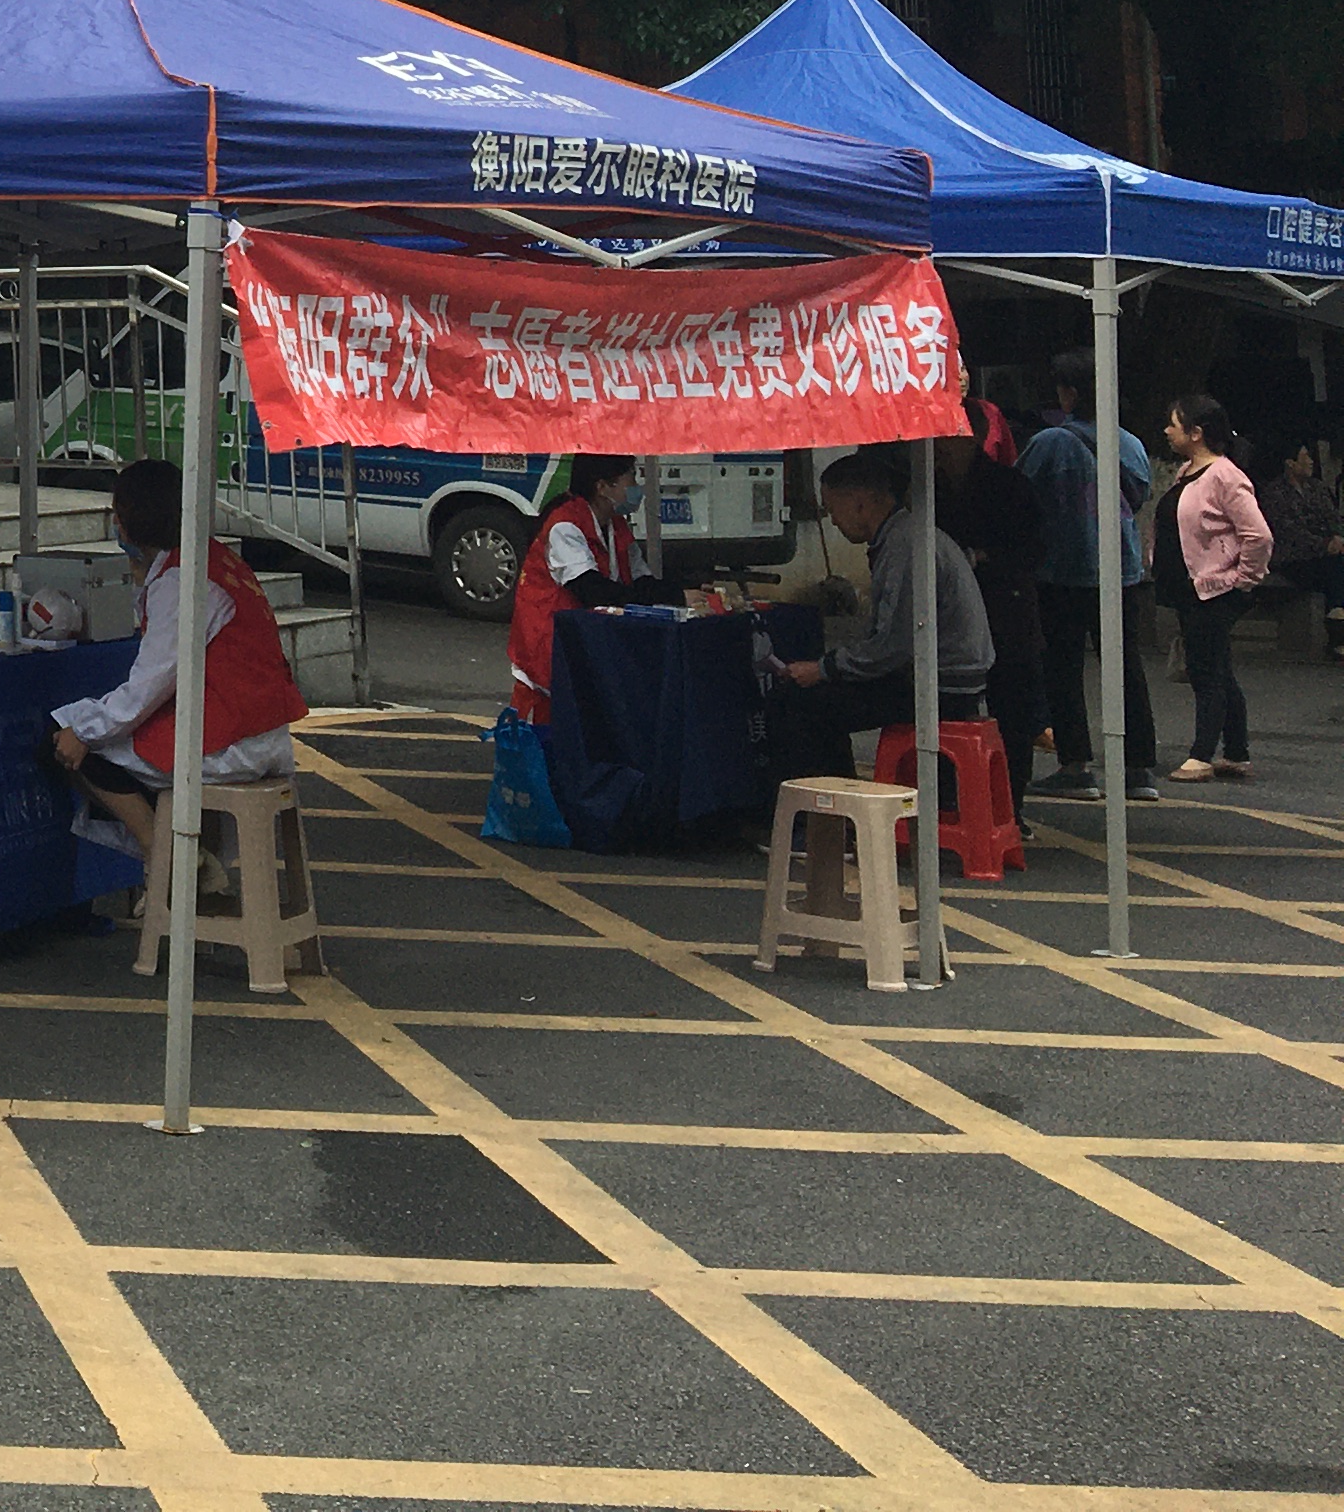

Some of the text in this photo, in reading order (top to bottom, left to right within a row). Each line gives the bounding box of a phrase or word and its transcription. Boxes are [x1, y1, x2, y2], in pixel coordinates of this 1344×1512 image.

[469, 130, 758, 215] 衡阳爱尔眼科医院
[469, 297, 952, 404] 志愿者进社区免费义诊服务
[358, 467, 422, 487] 8239955
